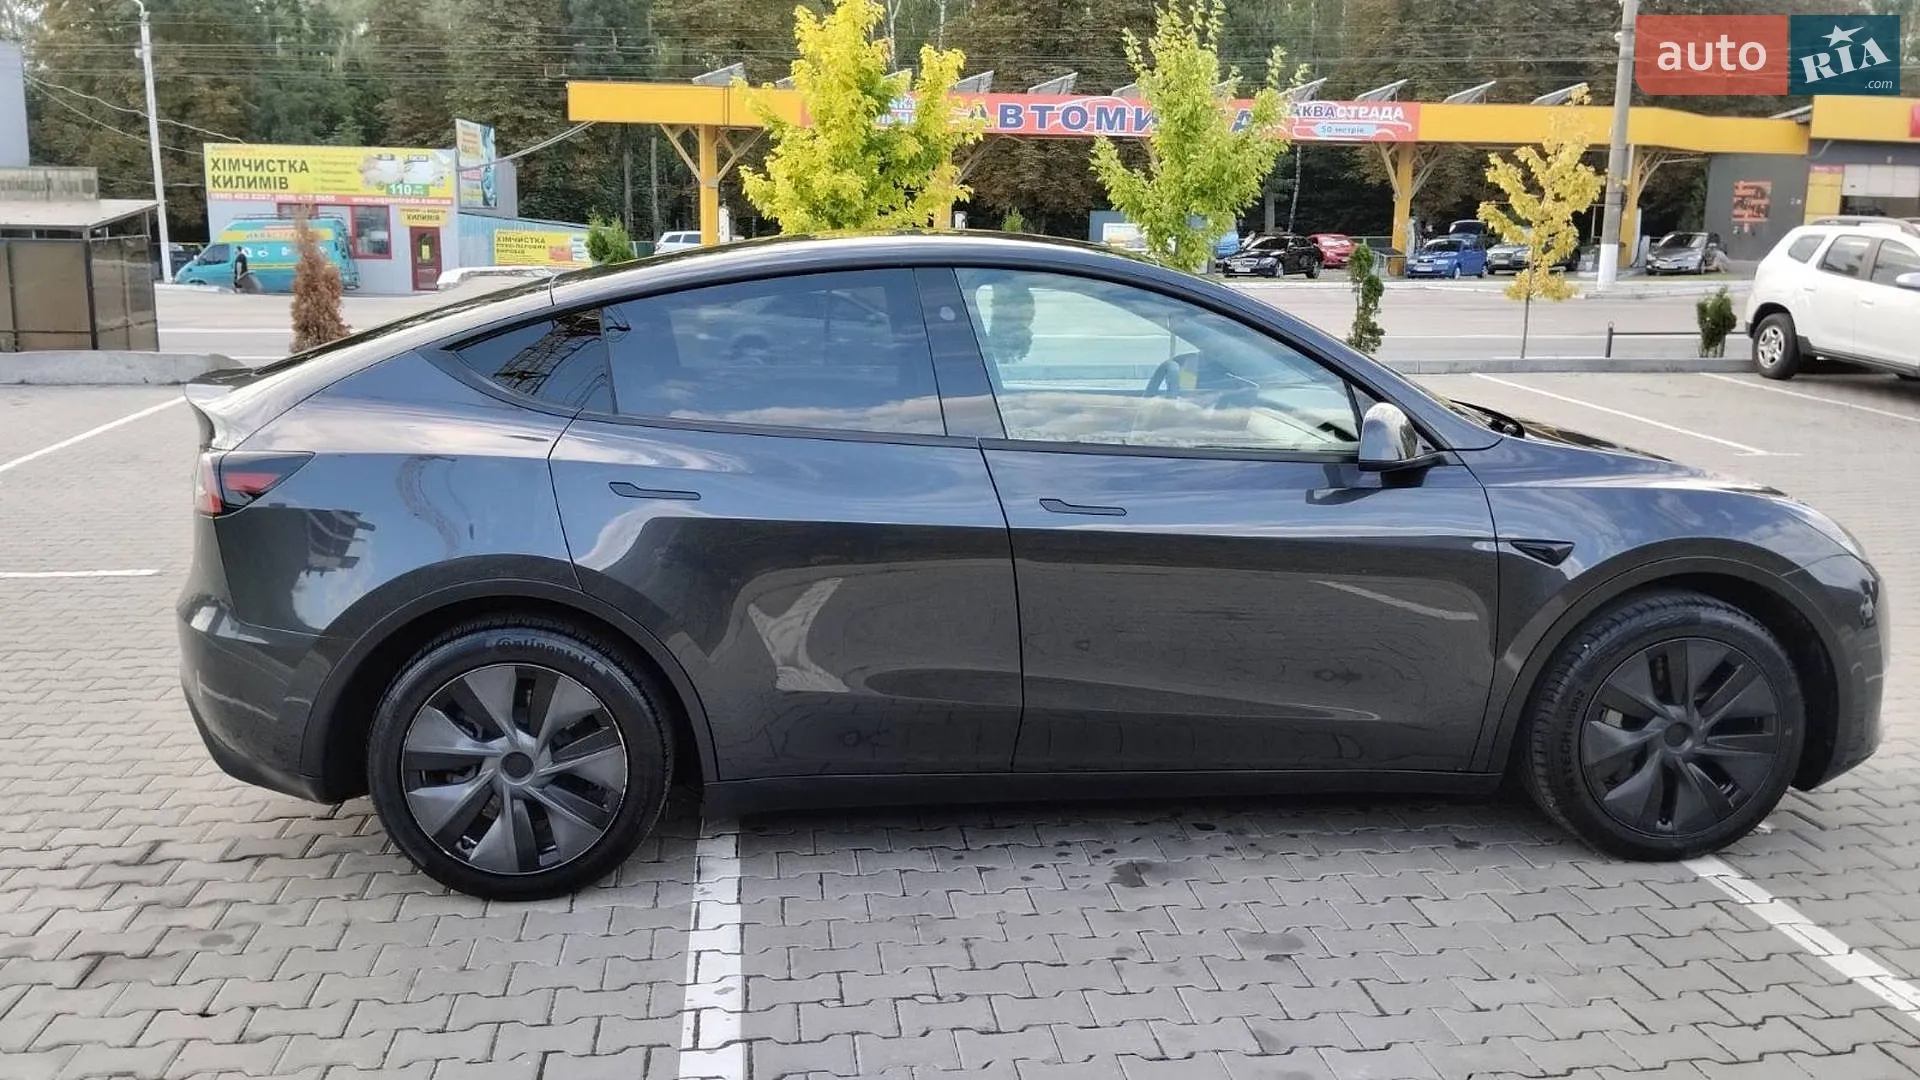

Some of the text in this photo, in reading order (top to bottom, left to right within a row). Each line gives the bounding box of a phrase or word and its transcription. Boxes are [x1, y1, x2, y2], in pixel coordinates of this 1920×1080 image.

[211, 158, 310, 173] ХІМЧИСТКА
[212, 175, 289, 190] КИЛИМІВ
[390, 184, 412, 196] 110
